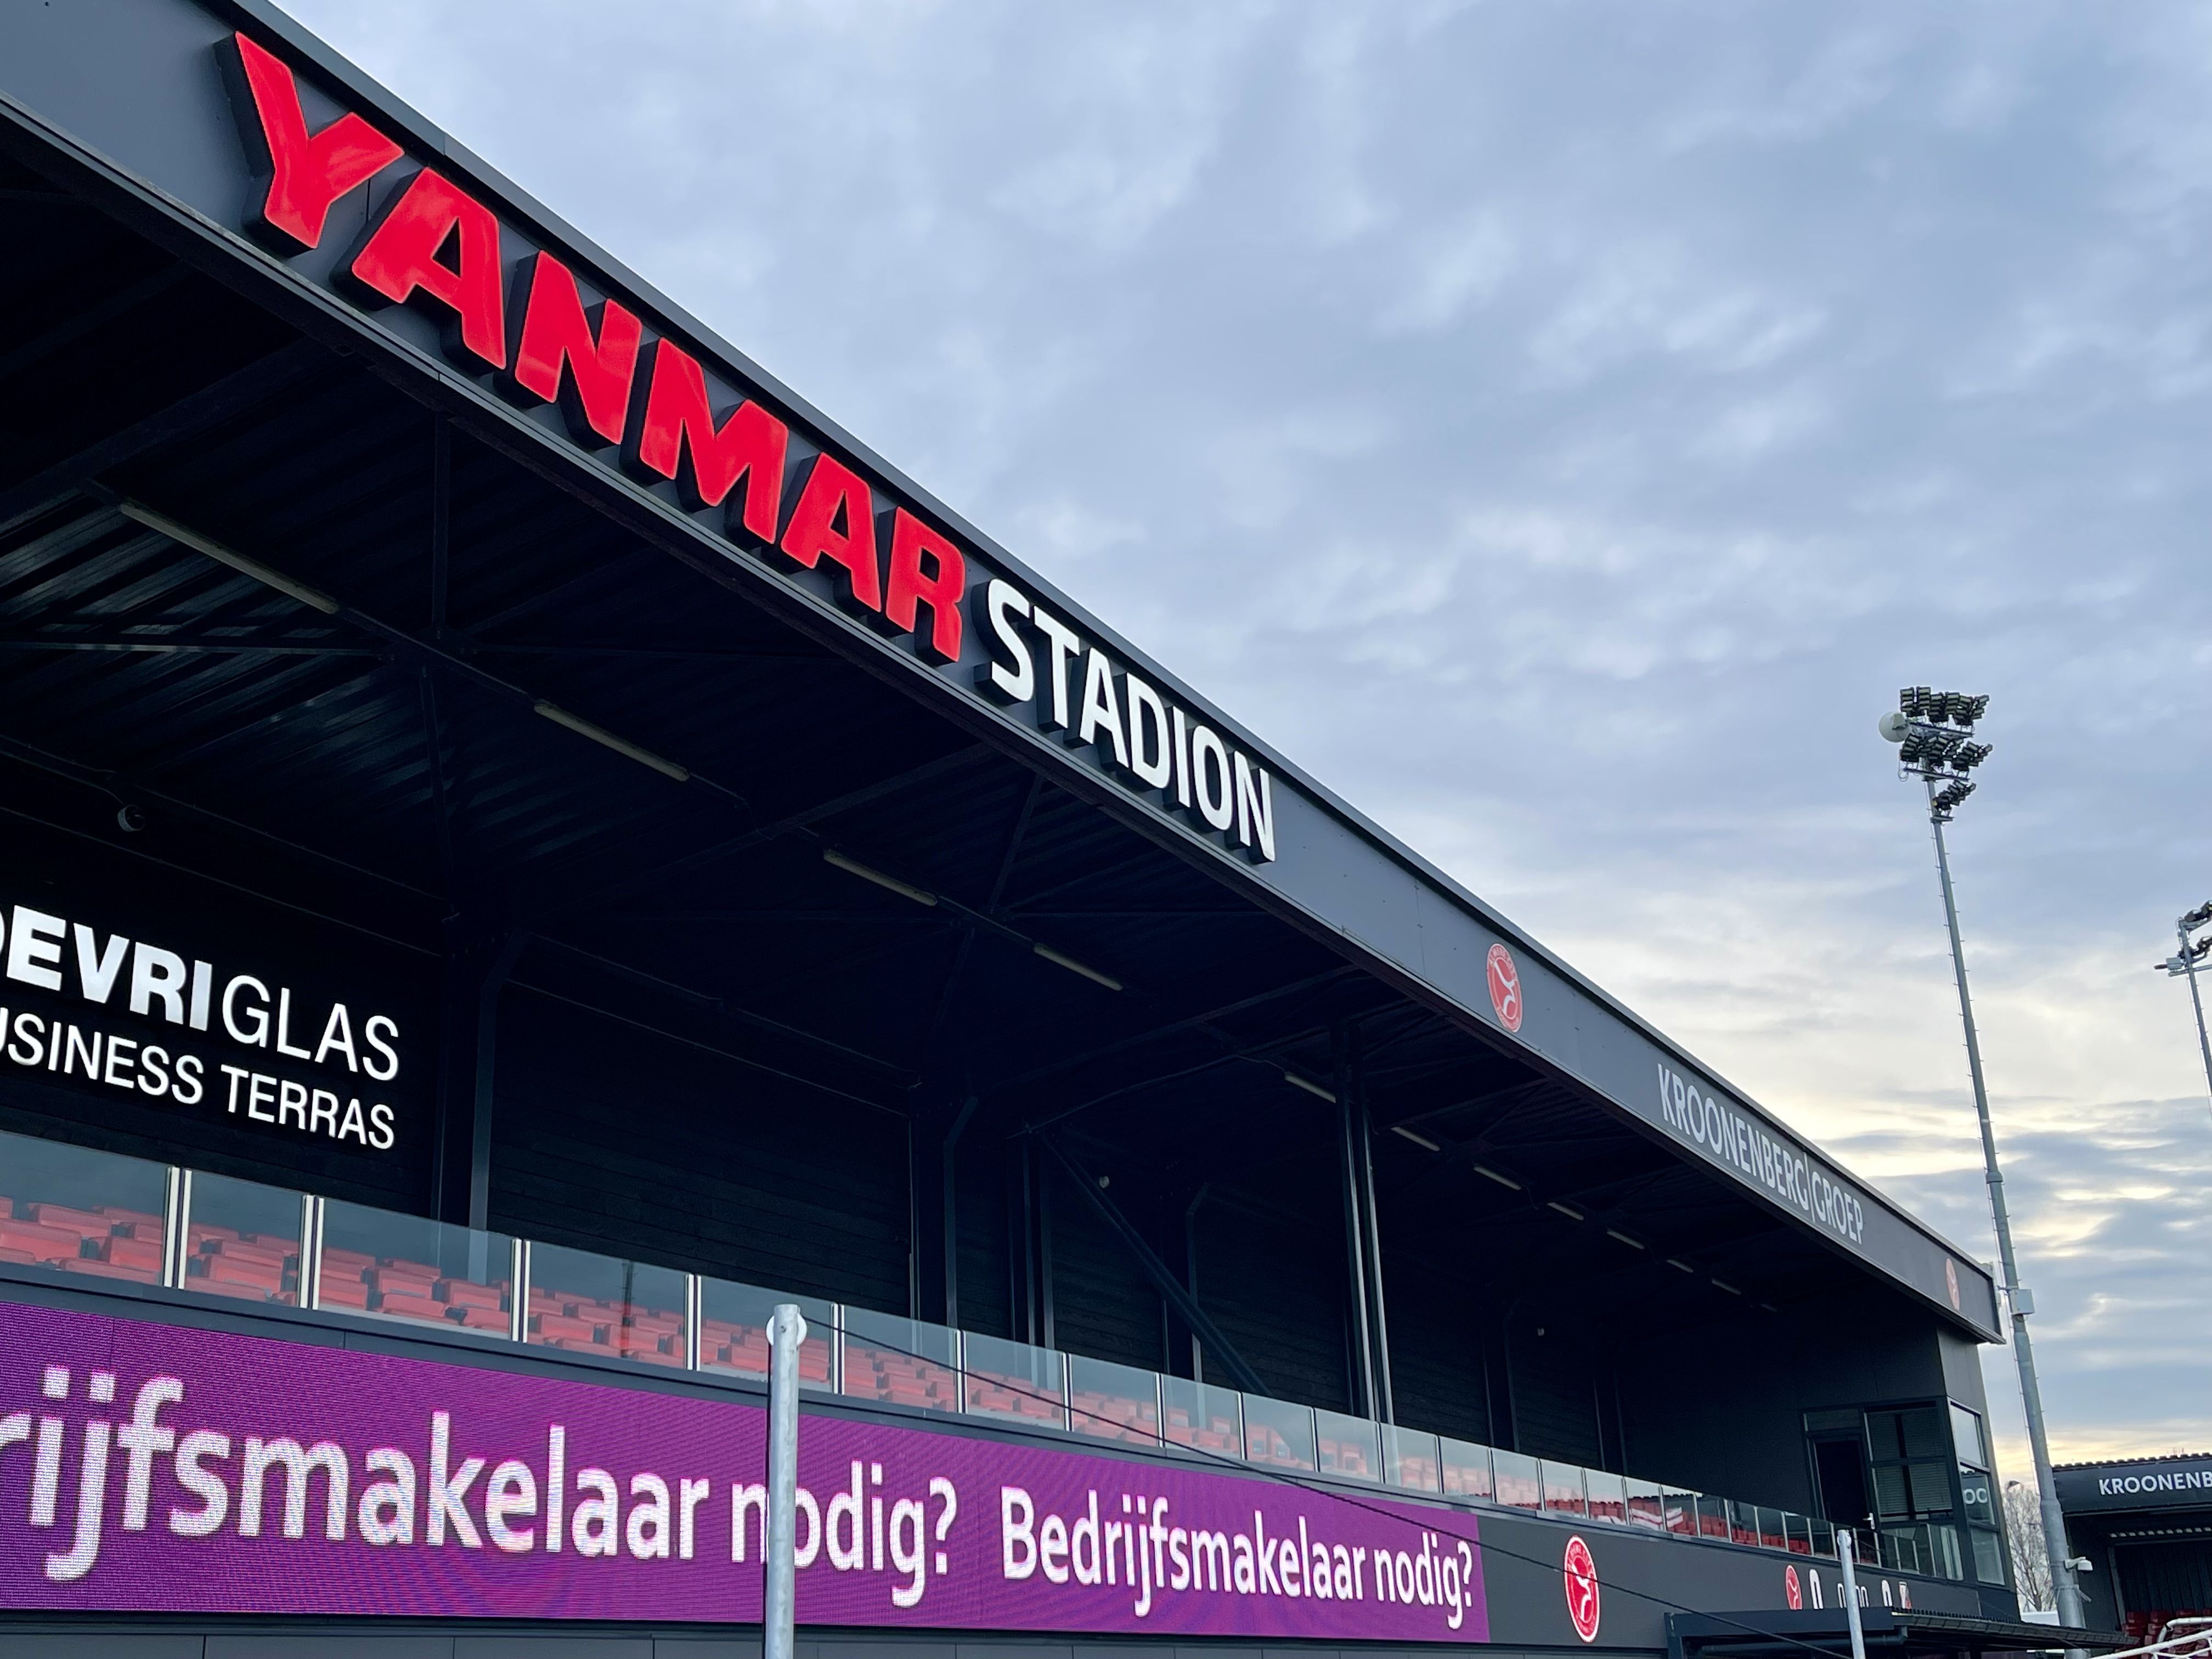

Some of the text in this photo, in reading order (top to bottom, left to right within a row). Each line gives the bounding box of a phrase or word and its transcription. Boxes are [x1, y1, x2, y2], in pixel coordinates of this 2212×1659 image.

[235, 31, 1275, 862] YANMAR STADION
[0, 905, 399, 1081] EVRIGLAS
[221, 1065, 395, 1149] TERRAS
[2098, 1471, 2212, 1496] KROONENB
[1001, 1486, 1366, 1617] Bedrijfsmakelaar
[1373, 1531, 1472, 1629] nodig?
